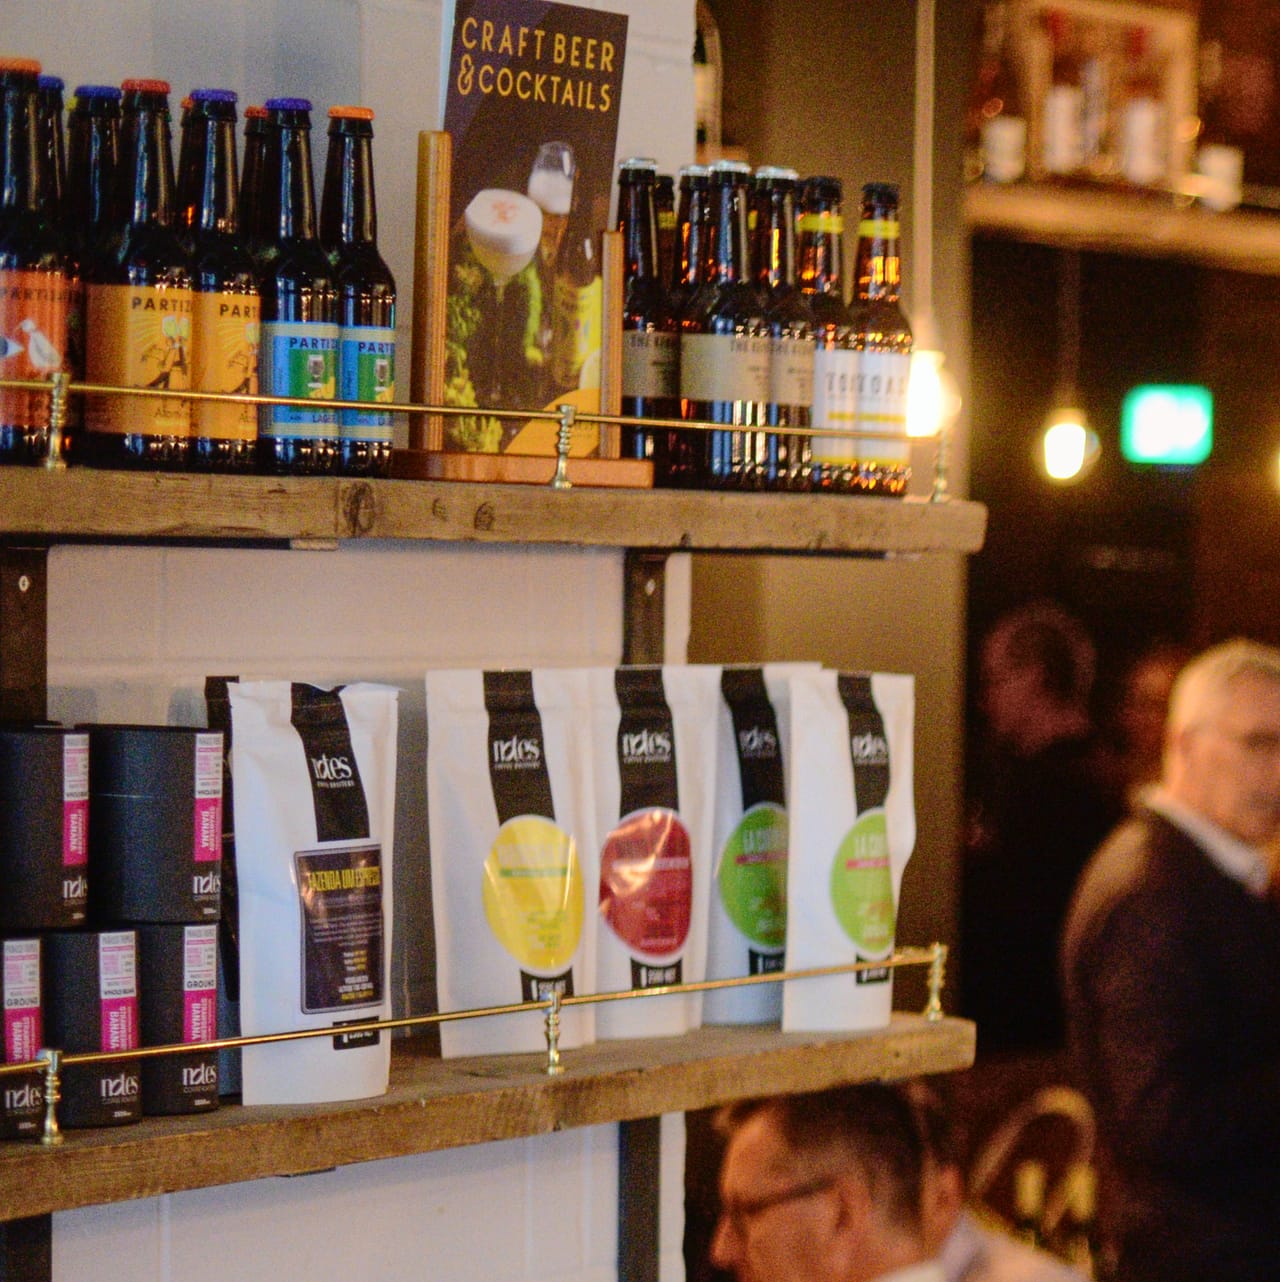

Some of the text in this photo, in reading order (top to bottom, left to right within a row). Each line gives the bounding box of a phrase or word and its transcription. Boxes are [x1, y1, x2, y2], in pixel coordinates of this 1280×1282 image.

[462, 17, 615, 72] CRAFT BEER
[478, 64, 611, 112] COCKTAILS
[69, 813, 79, 851] BANANA
[201, 810, 210, 848] BANANA
[100, 1071, 139, 1098] notes
